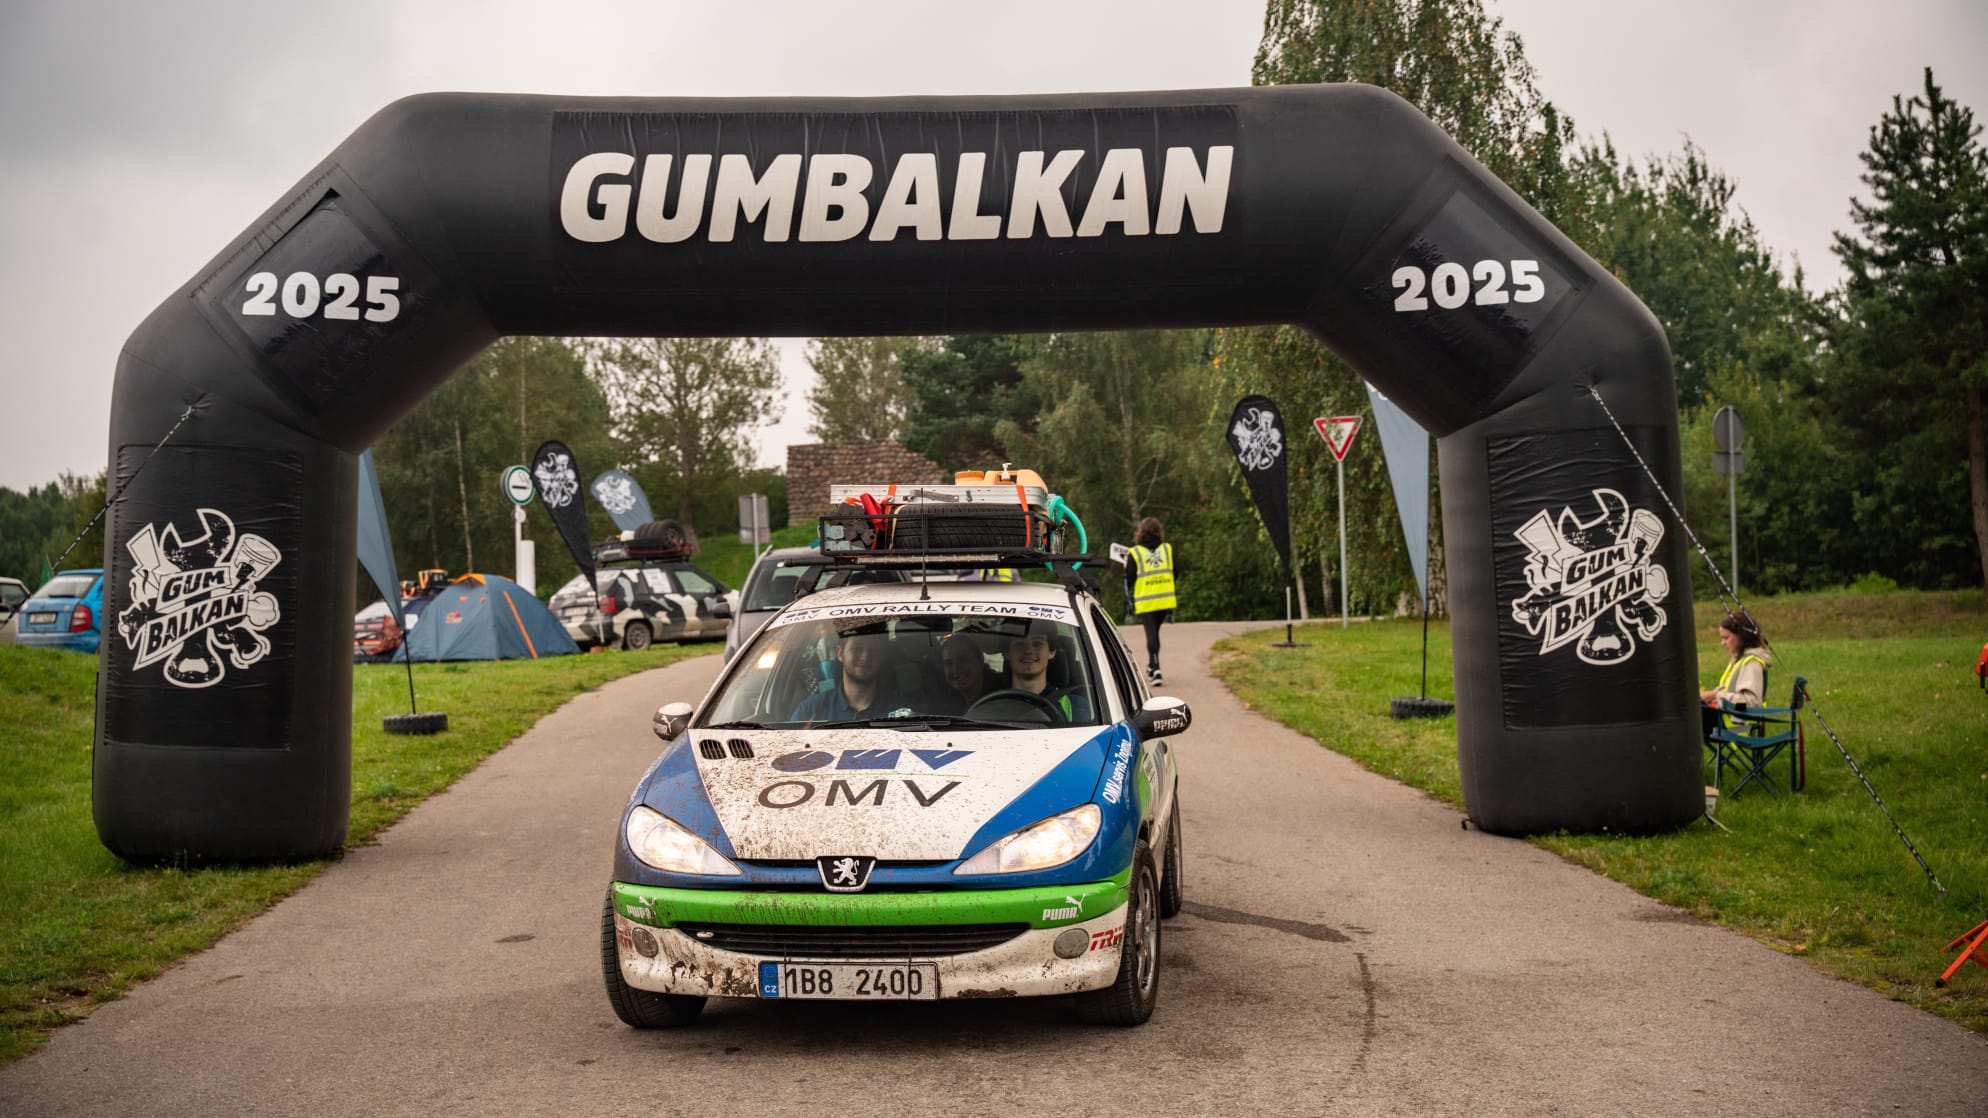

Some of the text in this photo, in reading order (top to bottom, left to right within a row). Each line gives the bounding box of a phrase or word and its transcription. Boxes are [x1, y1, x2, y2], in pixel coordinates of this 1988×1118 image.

[560, 145, 1234, 243] GUMBALKAN
[242, 271, 401, 323] 2025
[1391, 259, 1545, 312] 2025
[1566, 547, 1625, 586] GUM
[161, 569, 225, 603] GUM
[829, 605, 1017, 616] OMV RALLY TEAM
[1027, 611, 1065, 620] OMV
[1554, 568, 1643, 637] BALKAN
[147, 594, 244, 657] BALKAN
[758, 779, 963, 808] OMV
[1102, 778, 1122, 804] OMV
[1042, 907, 1078, 920] PUMA
[764, 984, 777, 993] CZ
[785, 968, 923, 996] 1B8 2400
